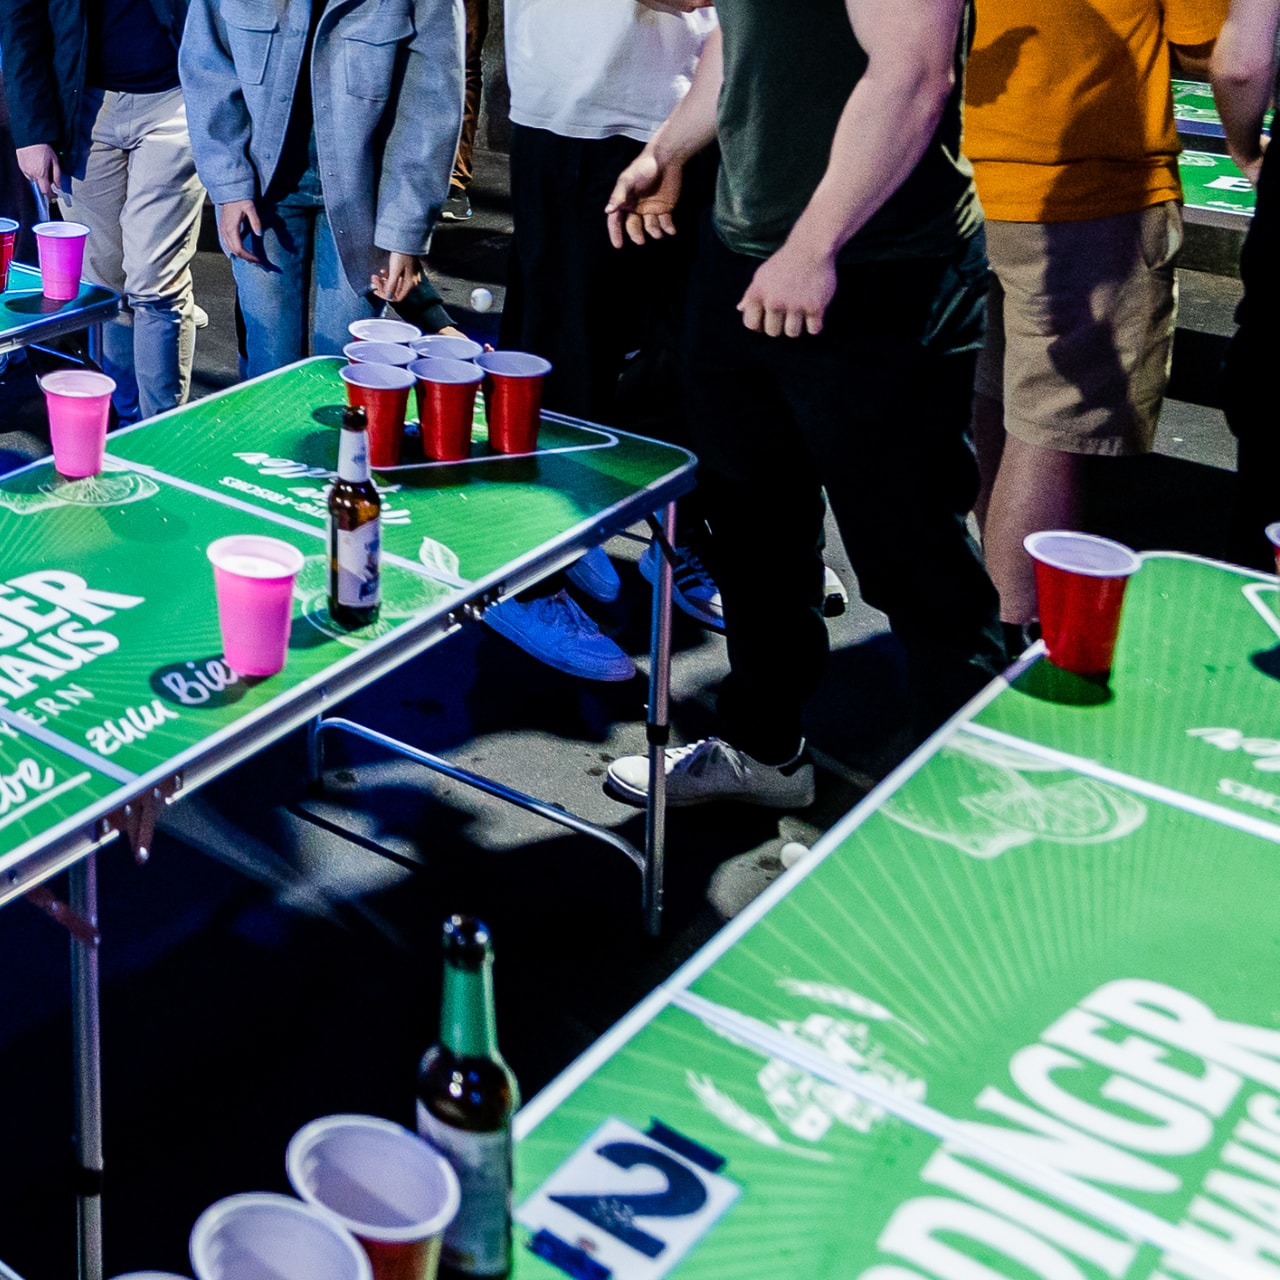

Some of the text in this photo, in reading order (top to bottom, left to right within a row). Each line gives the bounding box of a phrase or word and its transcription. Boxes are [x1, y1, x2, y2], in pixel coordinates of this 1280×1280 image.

[82, 699, 179, 756] zum
[856, 978, 1280, 1280] DINGER
[547, 1141, 709, 1258] 2
